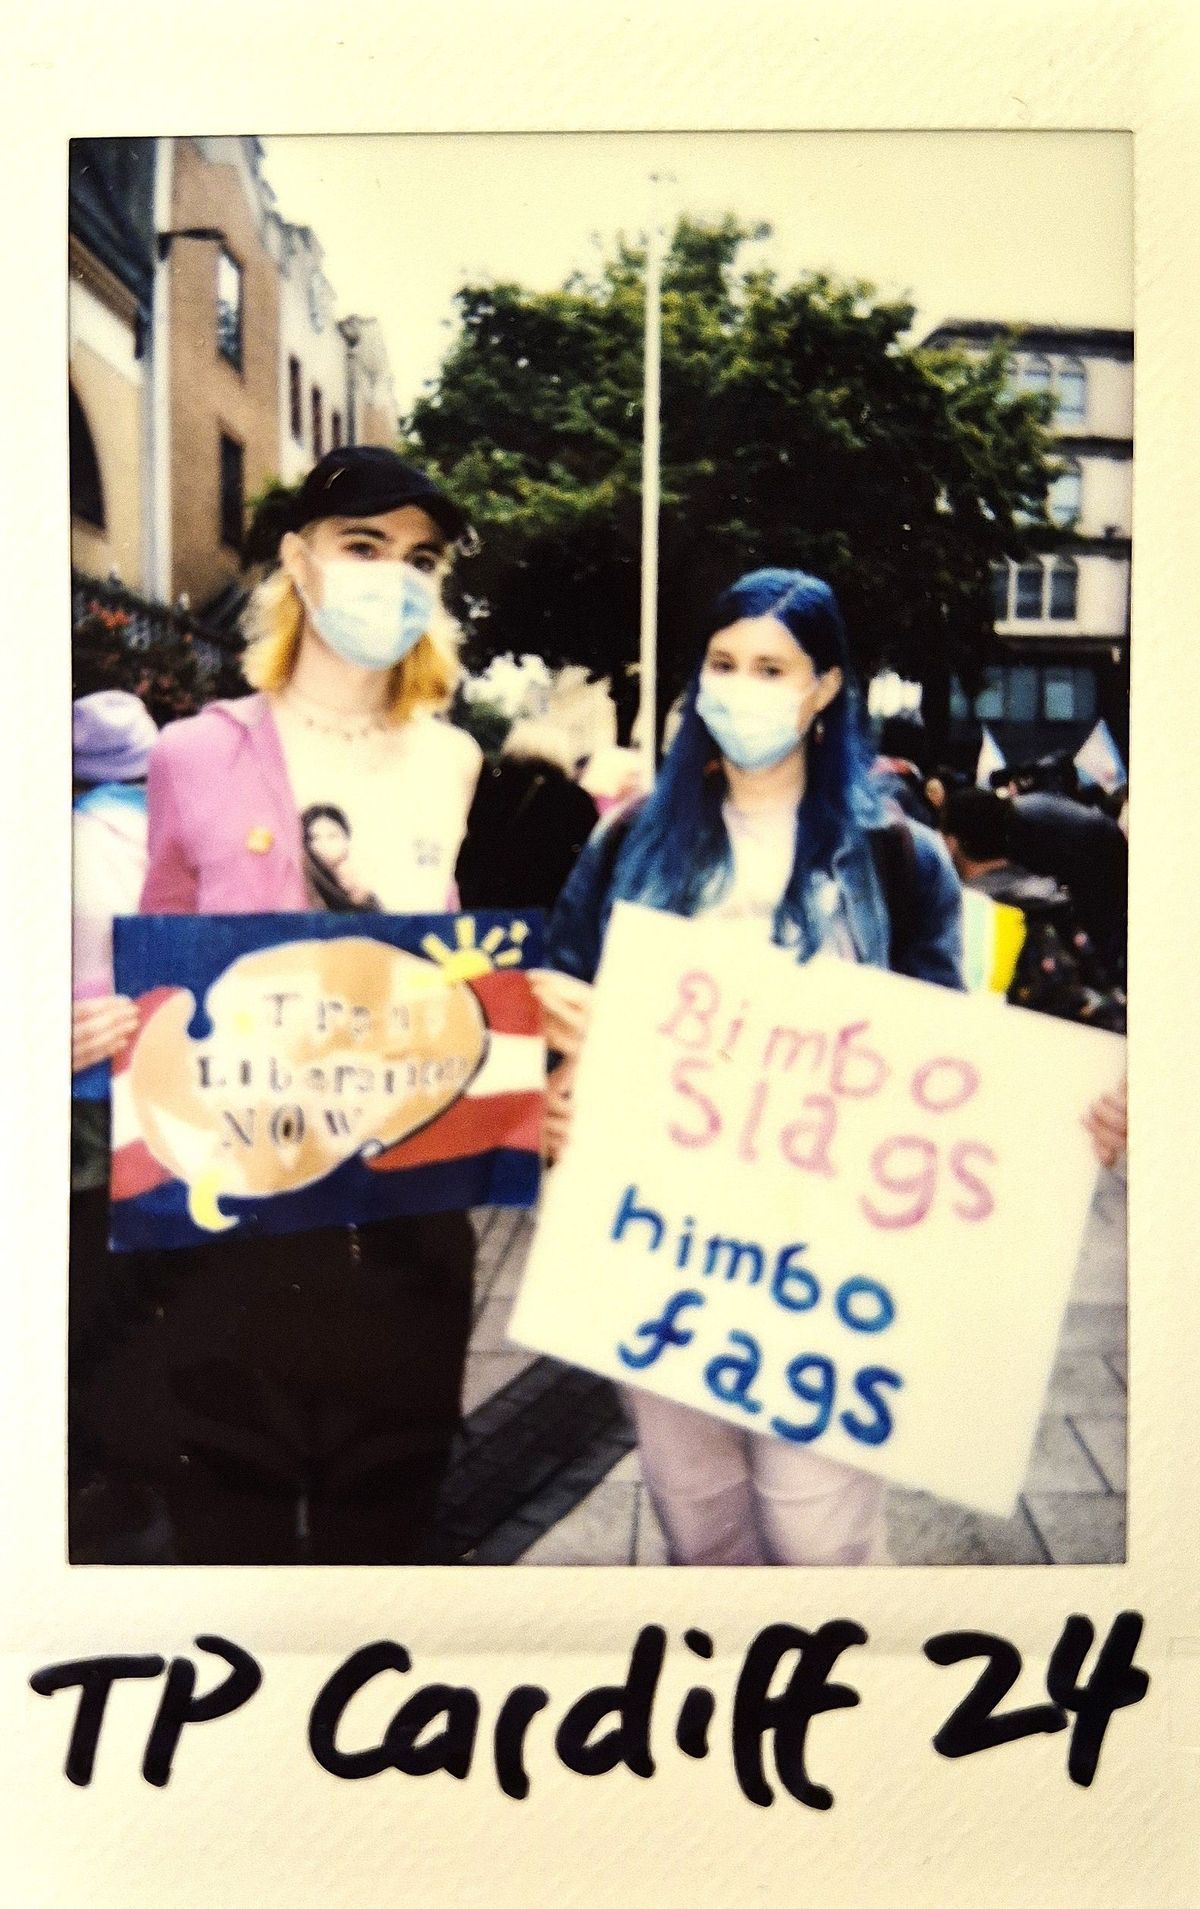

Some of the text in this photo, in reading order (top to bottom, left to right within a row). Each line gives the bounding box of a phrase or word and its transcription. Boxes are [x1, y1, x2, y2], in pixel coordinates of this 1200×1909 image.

[659, 970, 981, 1113] Bimbo
[222, 1104, 363, 1149] NOW
[667, 1057, 998, 1231] Slags
[610, 1184, 896, 1334] himbo
[617, 1289, 904, 1446] fags
[30, 1611, 1151, 1811] TP Cardiff 24
